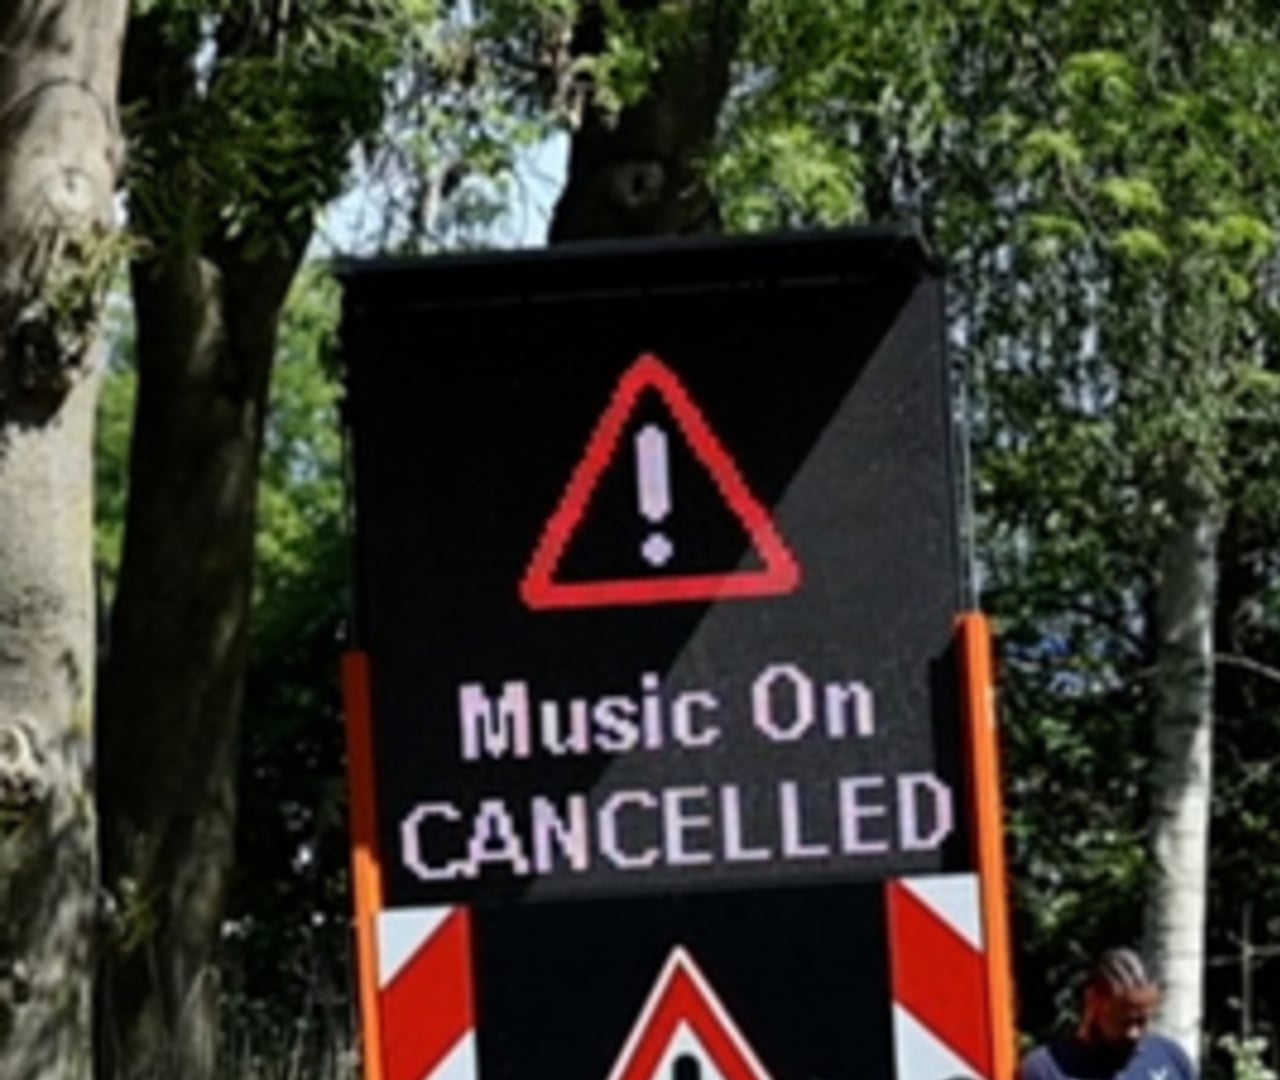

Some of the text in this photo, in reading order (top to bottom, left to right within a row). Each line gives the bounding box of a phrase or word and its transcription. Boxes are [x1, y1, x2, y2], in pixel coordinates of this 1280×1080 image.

[459, 663, 875, 760] Music On
[400, 771, 953, 881] CANCELLED
